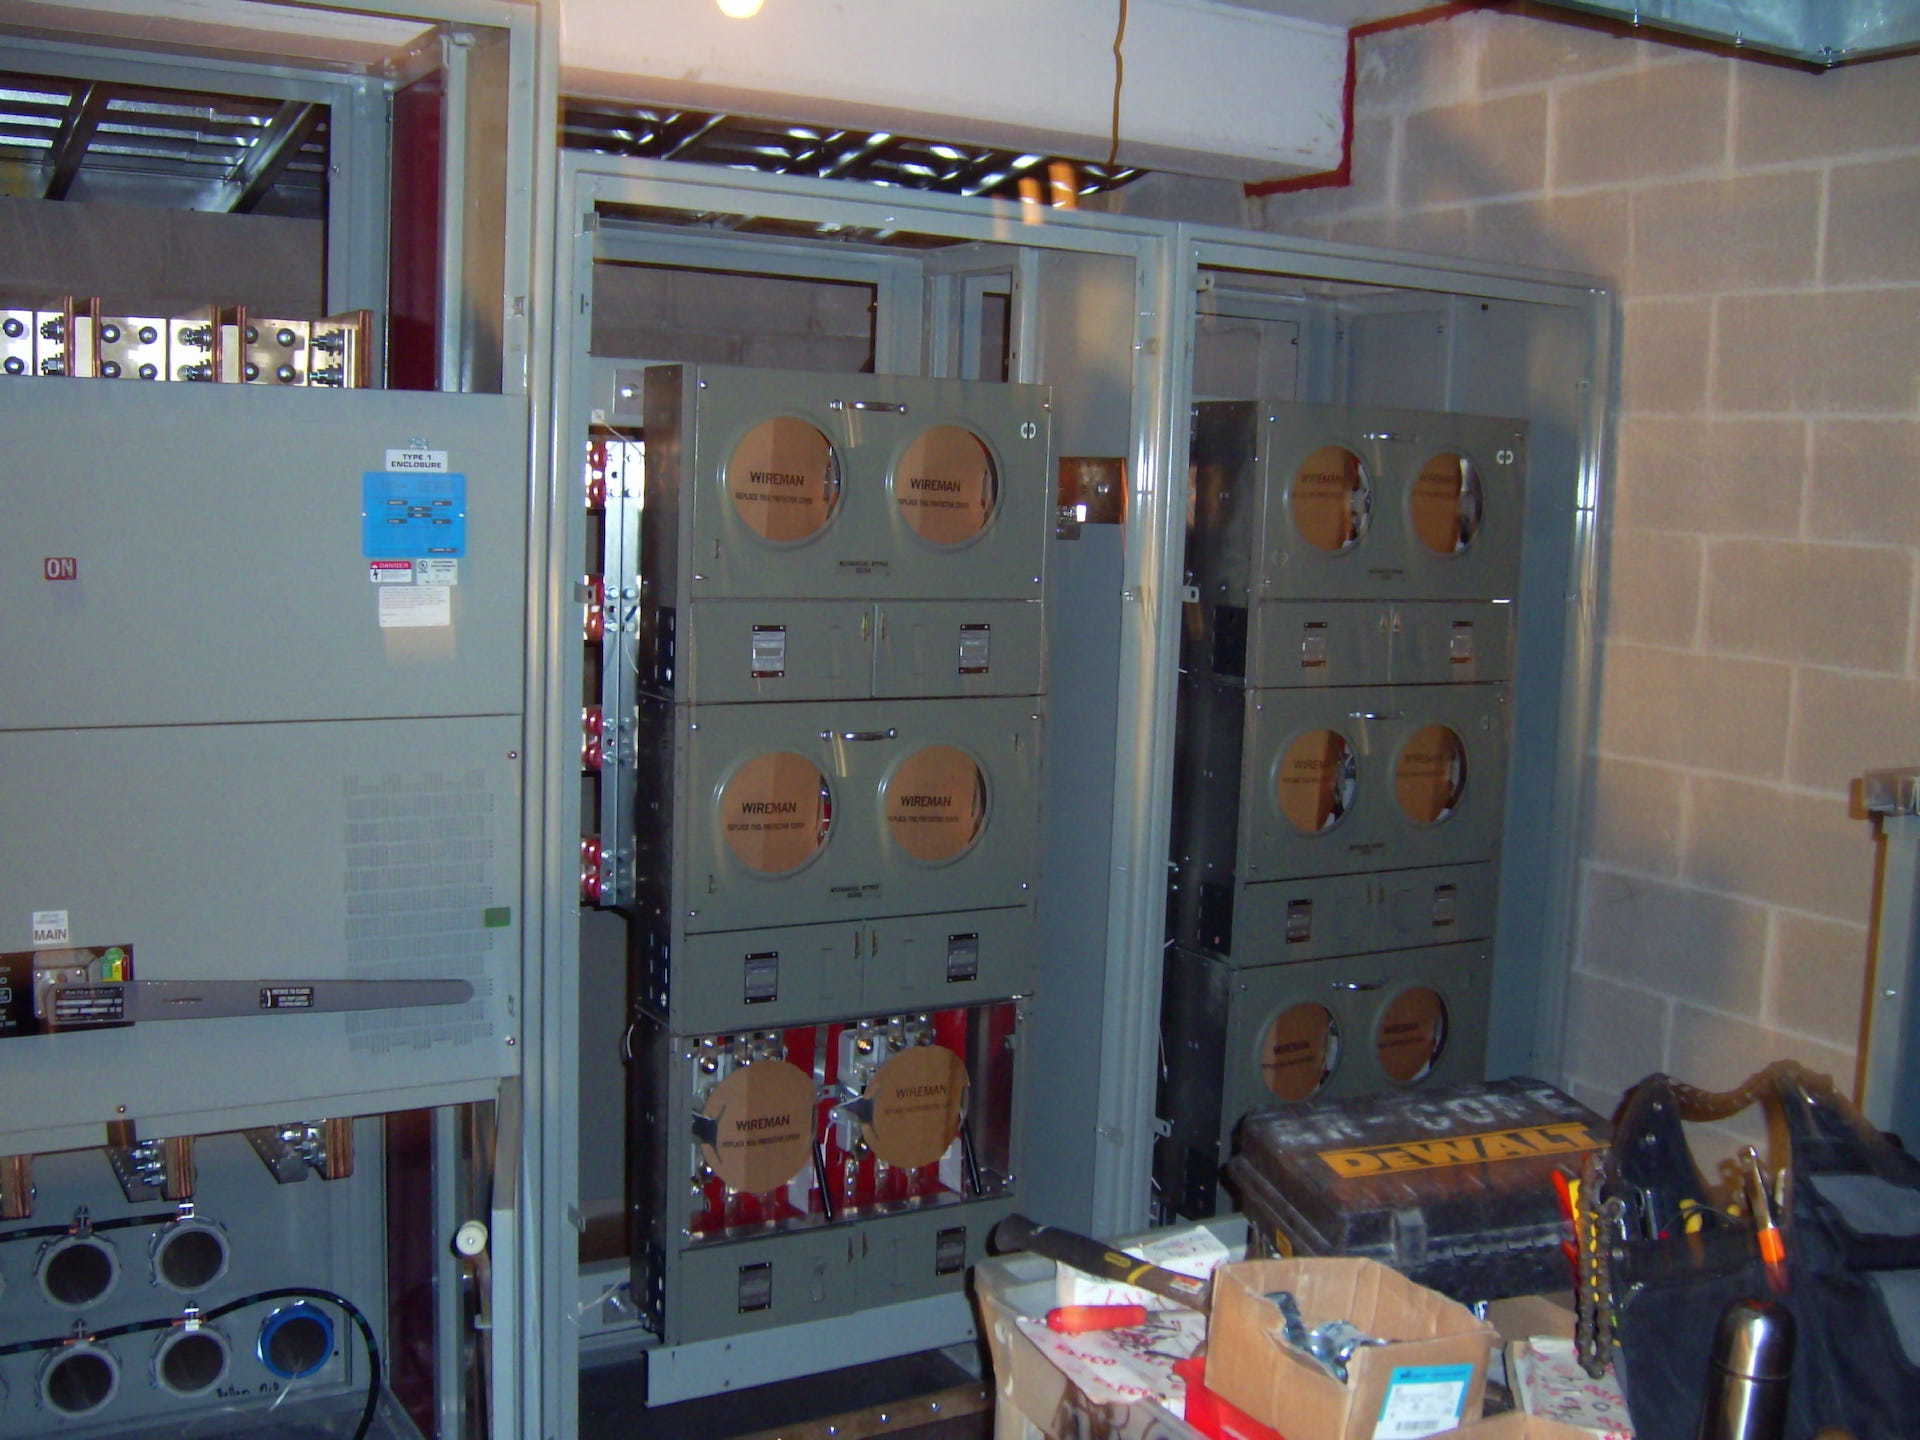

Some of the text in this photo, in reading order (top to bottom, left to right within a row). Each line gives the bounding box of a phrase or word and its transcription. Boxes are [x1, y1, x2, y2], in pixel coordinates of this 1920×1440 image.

[402, 453, 432, 461] TYPE 1
[391, 461, 442, 469] ENCLOSURE
[750, 471, 805, 487] WIREMAN
[910, 478, 961, 493] WIREMAN
[47, 558, 74, 578] ON
[742, 802, 797, 815] WIREMAN
[900, 795, 952, 808] WIREMAN
[34, 928, 67, 941] MAIN
[735, 1114, 791, 1132] WIREMAN
[1320, 1123, 1602, 1178] DEWALT
